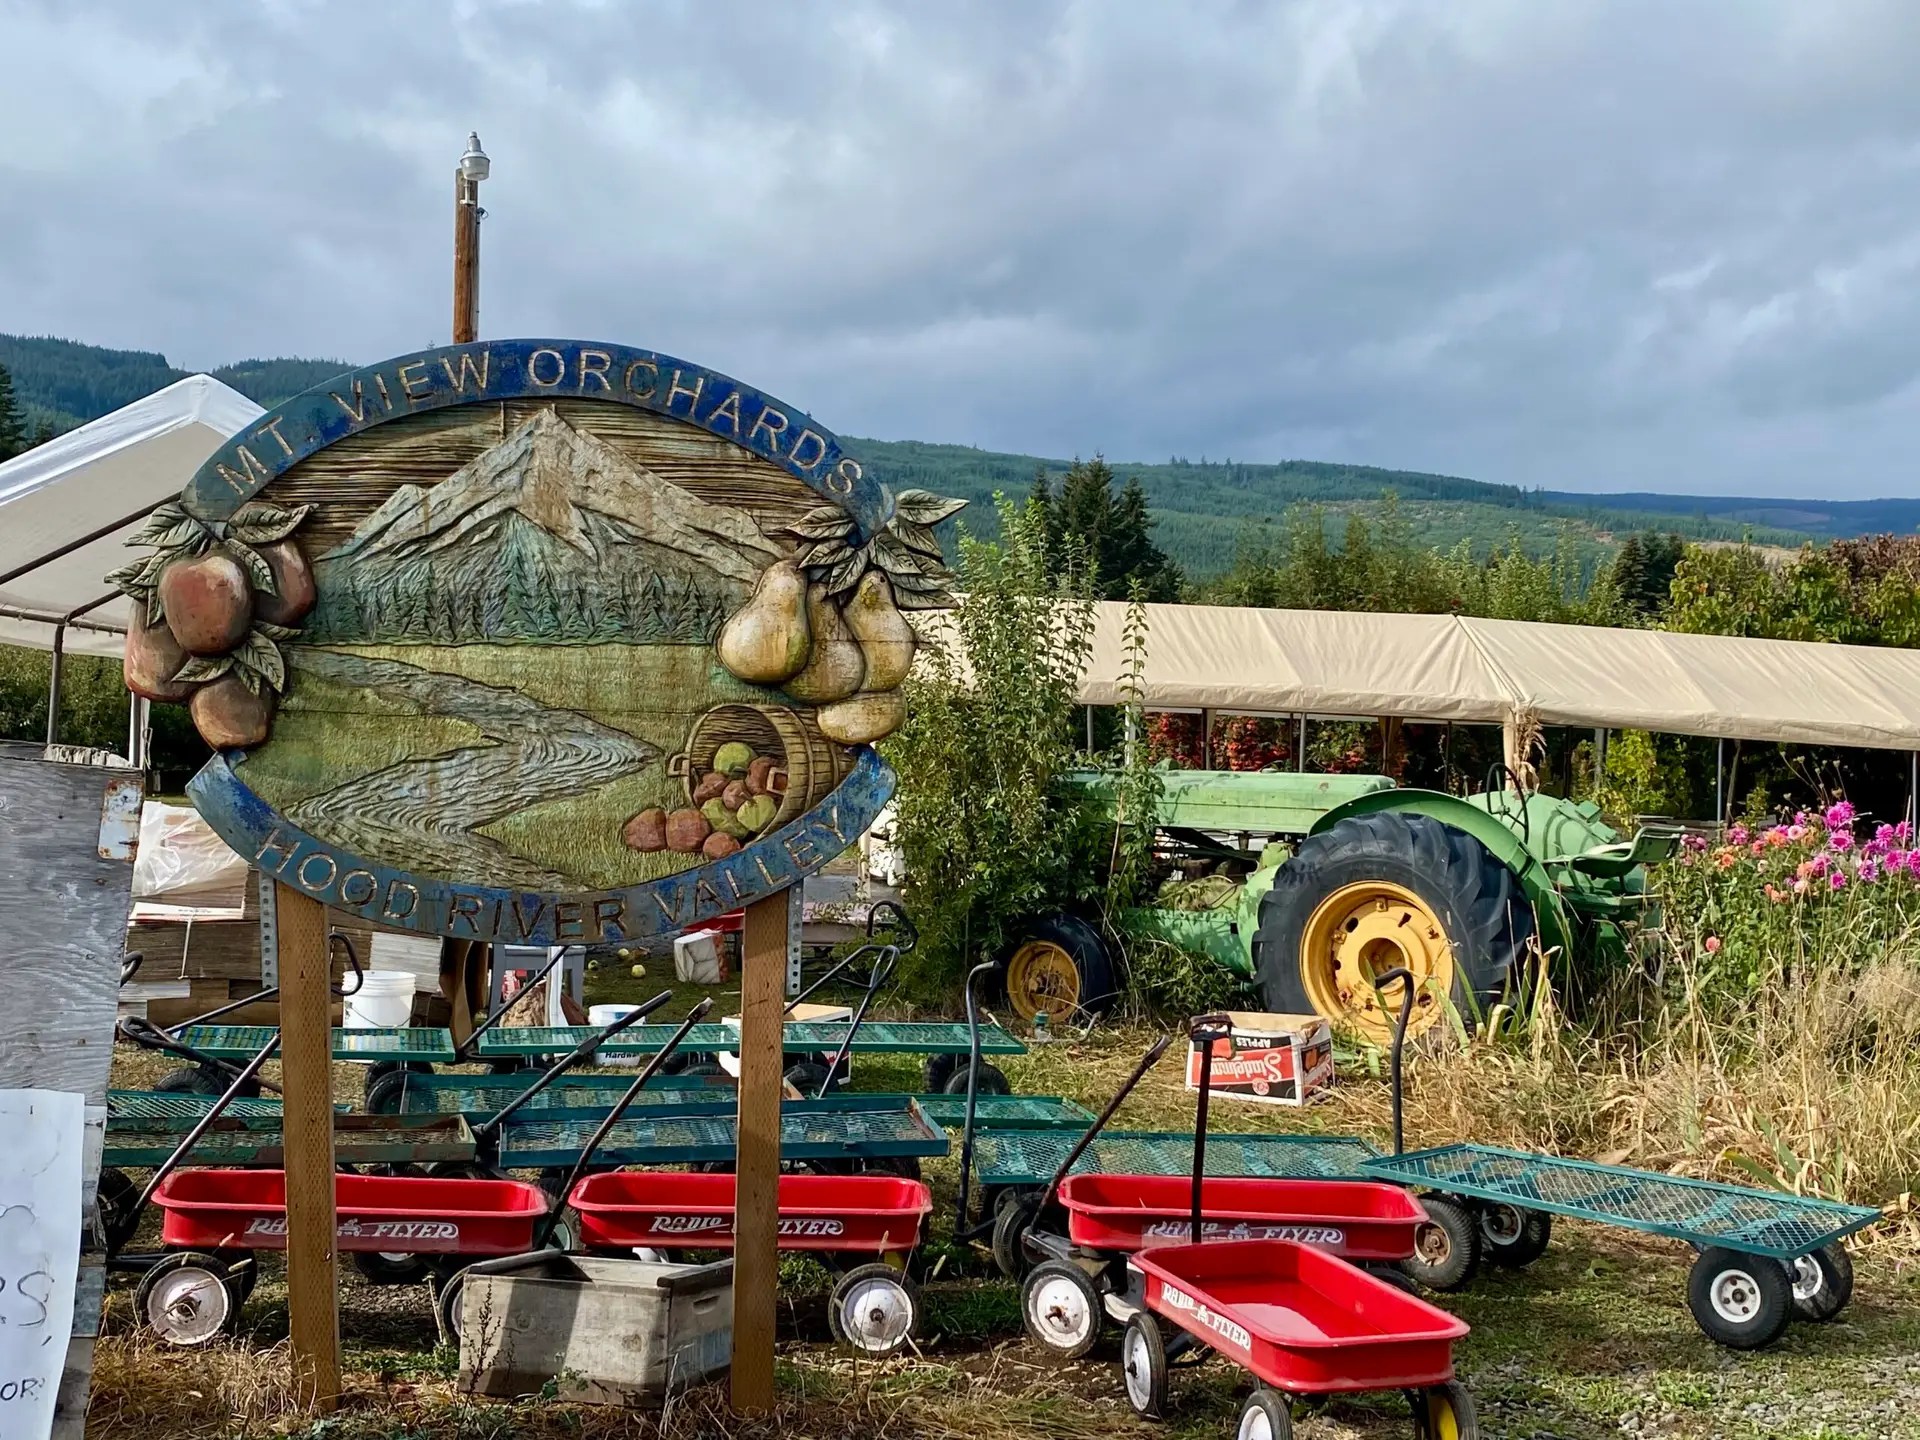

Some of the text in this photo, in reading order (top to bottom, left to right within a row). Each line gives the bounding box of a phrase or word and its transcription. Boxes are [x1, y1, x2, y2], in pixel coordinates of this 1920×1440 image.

[329, 351, 489, 422] VIEW
[528, 349, 862, 494] ORCHARDS
[256, 805, 847, 940] HOOD RIVER VALLEY
[1236, 1037, 1271, 1048] APPLES
[372, 1222, 459, 1238] FLYER
[648, 1216, 843, 1235] RADIO LYER
[1263, 1226, 1343, 1244] FLYER
[1162, 1282, 1251, 1351] RADIO FLYER
